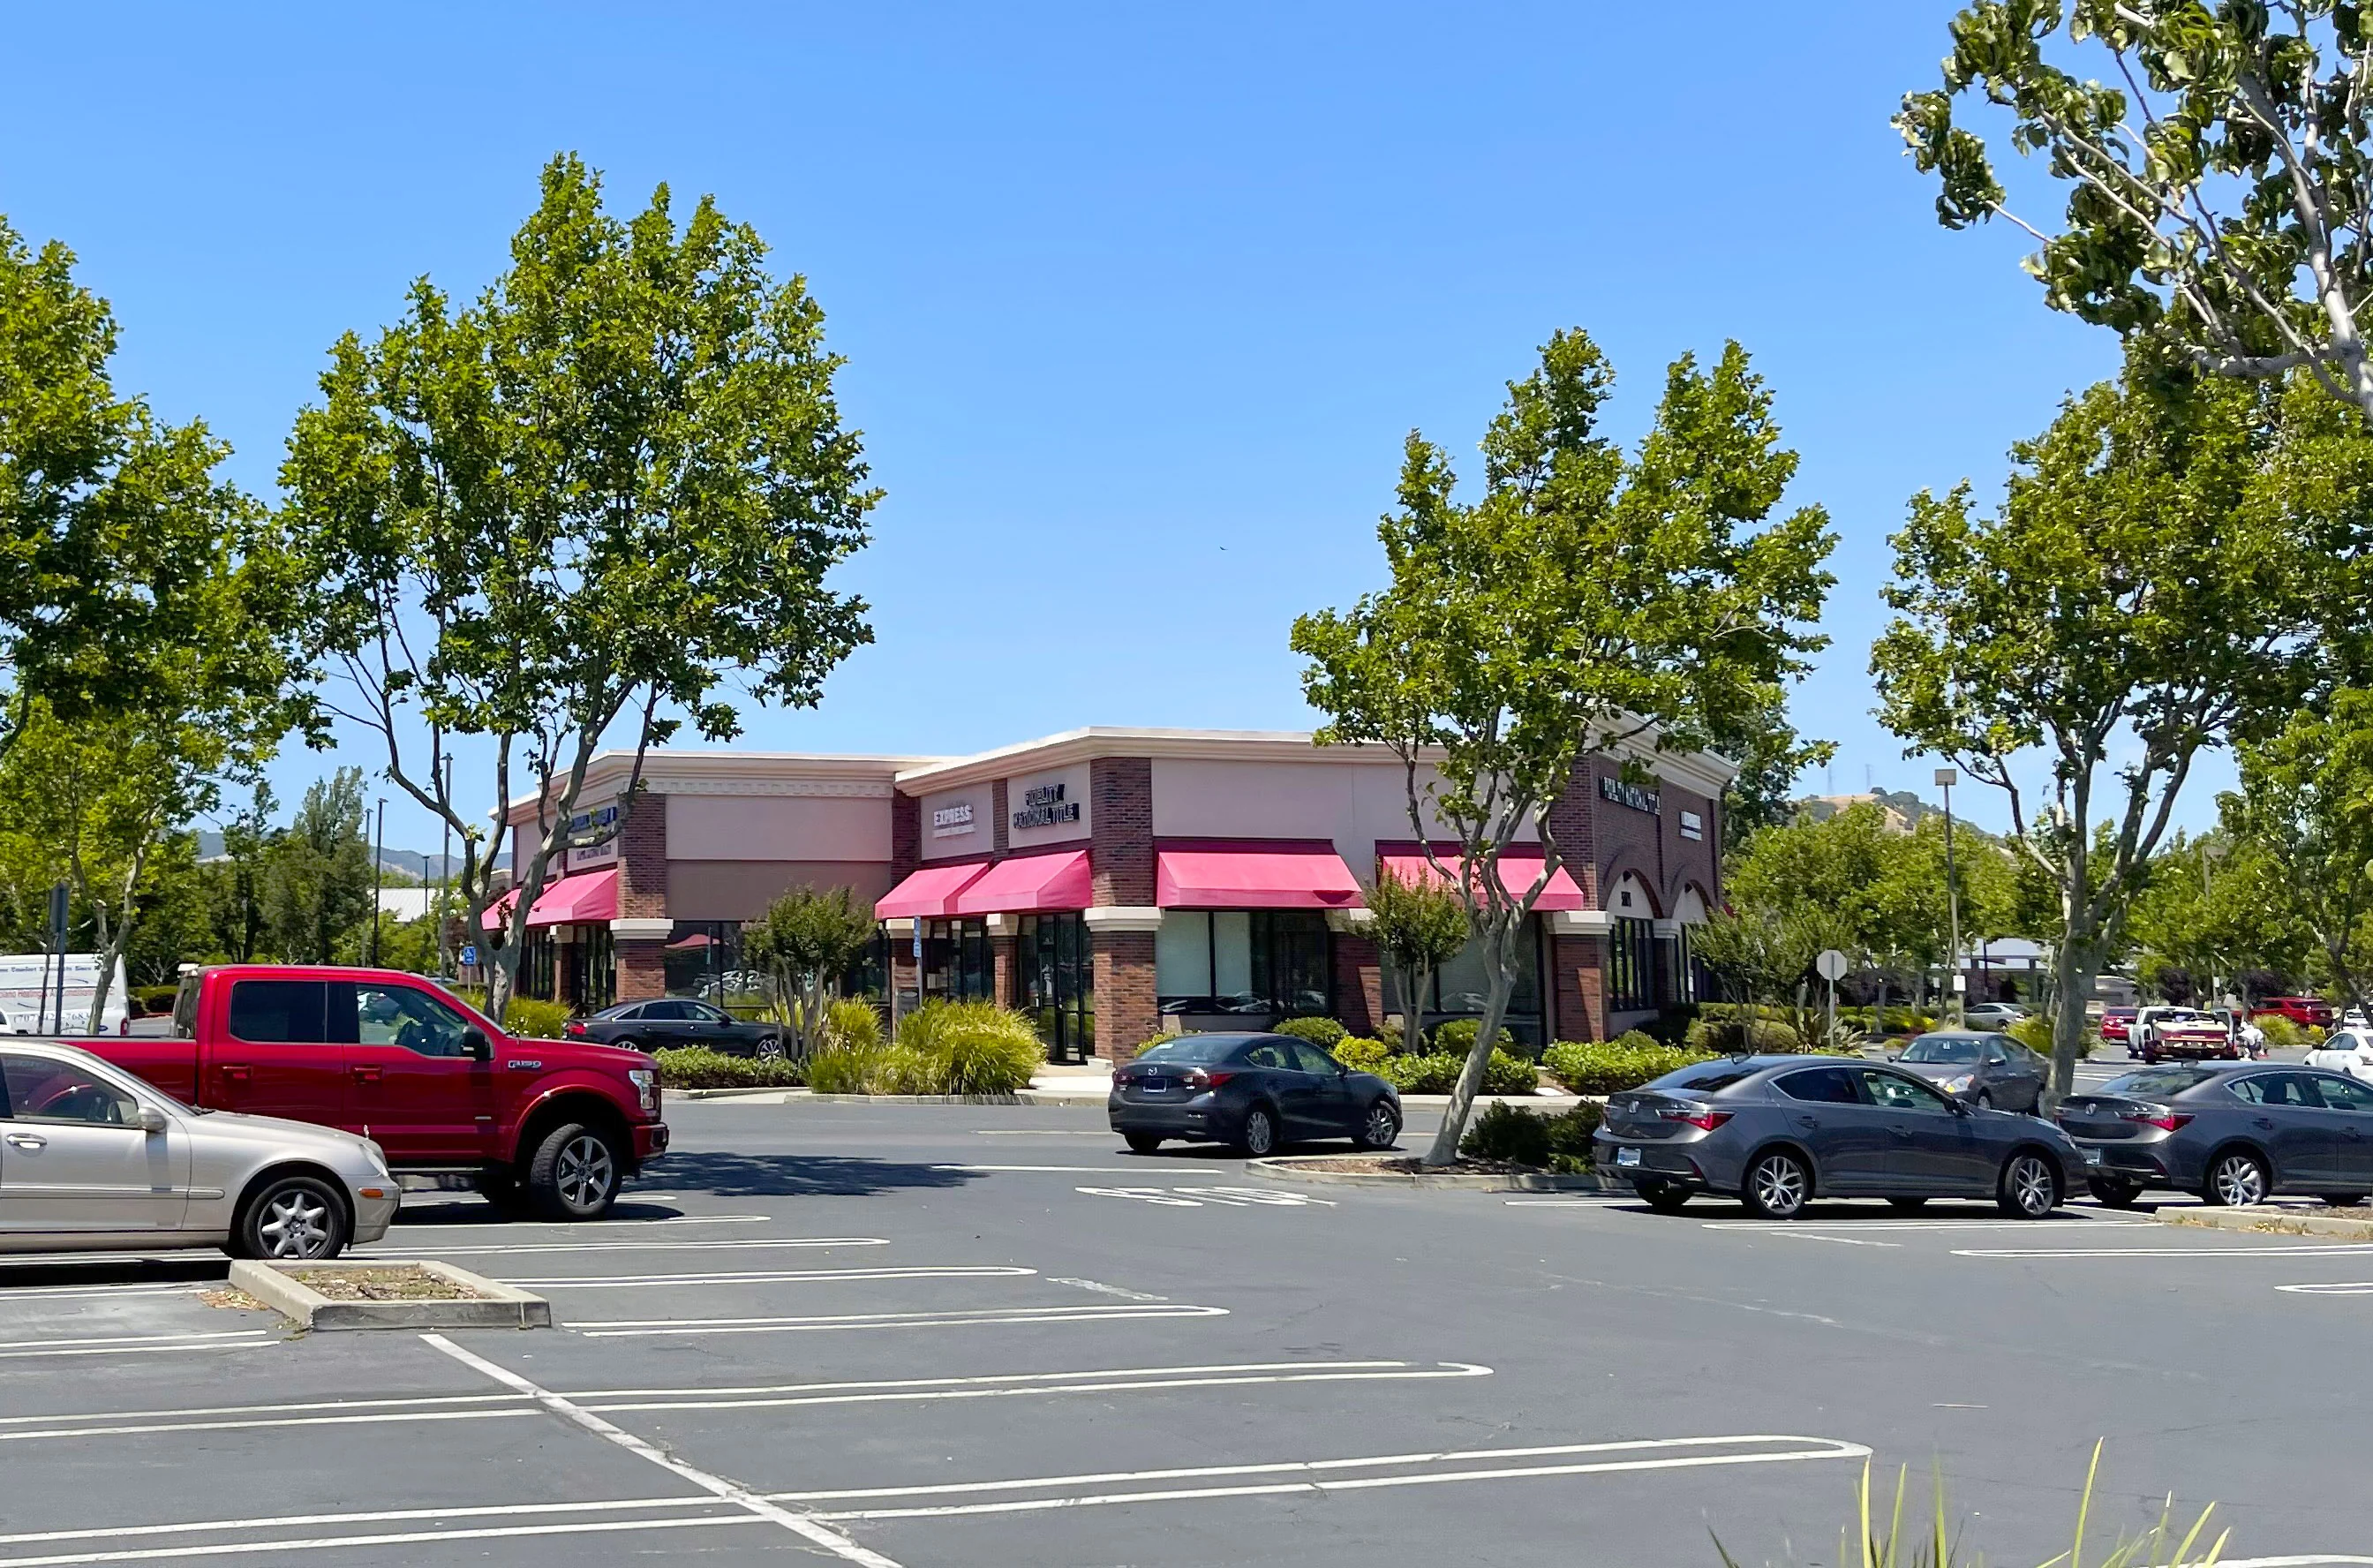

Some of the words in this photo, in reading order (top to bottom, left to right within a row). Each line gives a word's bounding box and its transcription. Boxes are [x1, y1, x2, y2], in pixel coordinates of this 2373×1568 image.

[1025, 784, 1065, 805] FIDELITY
[1013, 807, 1051, 829] NATIONAL
[1051, 803, 1080, 824] TITLE
